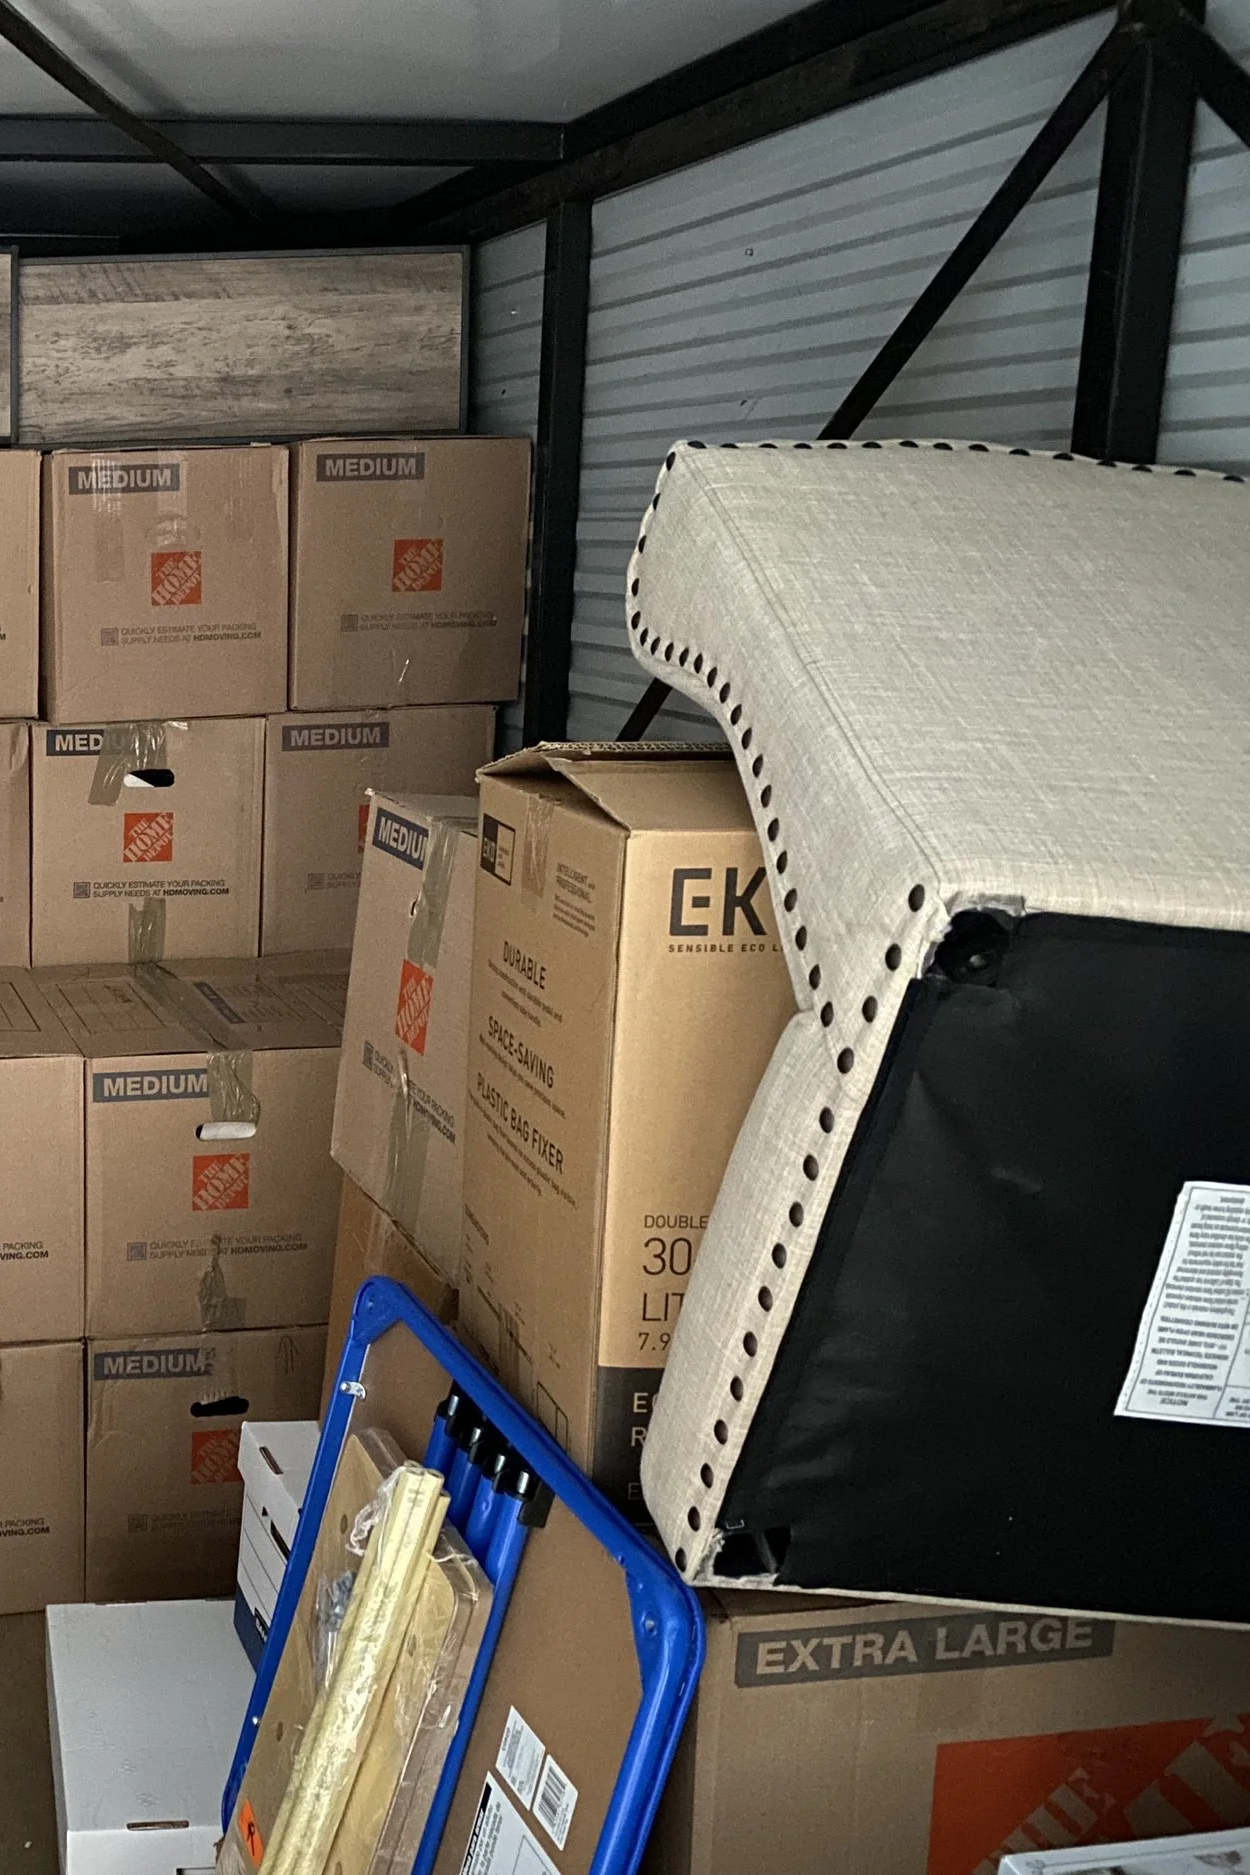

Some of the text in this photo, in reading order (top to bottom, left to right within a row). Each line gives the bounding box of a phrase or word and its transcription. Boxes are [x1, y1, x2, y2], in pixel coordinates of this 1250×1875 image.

[325, 457, 416, 477] MEDIUM
[78, 468, 172, 490] MEDIUM
[157, 558, 178, 580] THE
[392, 538, 444, 592] HOME
[151, 551, 202, 606] HOME
[170, 572, 202, 605] DEPOT
[291, 727, 381, 747] MEDIUM
[123, 811, 174, 863] HOME
[129, 819, 149, 838] THE
[143, 832, 174, 862] DEPOT
[93, 879, 226, 889] QUICKLY ESTIMATE YOUR PACKING
[93, 889, 123, 898] SUPPLY
[124, 889, 151, 897] NEEDS
[163, 887, 230, 897] HDMOVING.COM
[669, 867, 768, 936] EK
[668, 944, 735, 953] SENSIBLE
[741, 943, 766, 952] ECO
[503, 941, 547, 990] DURABLE
[488, 1015, 554, 1089] SPACE-SAVING
[103, 1073, 208, 1098] MEDIUM
[477, 1072, 508, 1122] PLASTIC
[511, 1108, 529, 1144] BAG
[531, 1128, 564, 1175] FIXER
[192, 1153, 250, 1212] HOME
[199, 1160, 221, 1184] THE
[644, 1214, 709, 1230] DOUBLE
[2, 1241, 43, 1252] PACKING
[150, 1239, 190, 1250] QUICKLY
[150, 1249, 186, 1260] SUPPLY
[230, 1243, 308, 1255] HDMOVING.COM
[642, 1292, 686, 1322] LIT
[104, 1353, 206, 1376] MEDIUM
[4, 1517, 45, 1528] PACKING
[755, 1616, 1093, 1675] EXTRA LARGE
